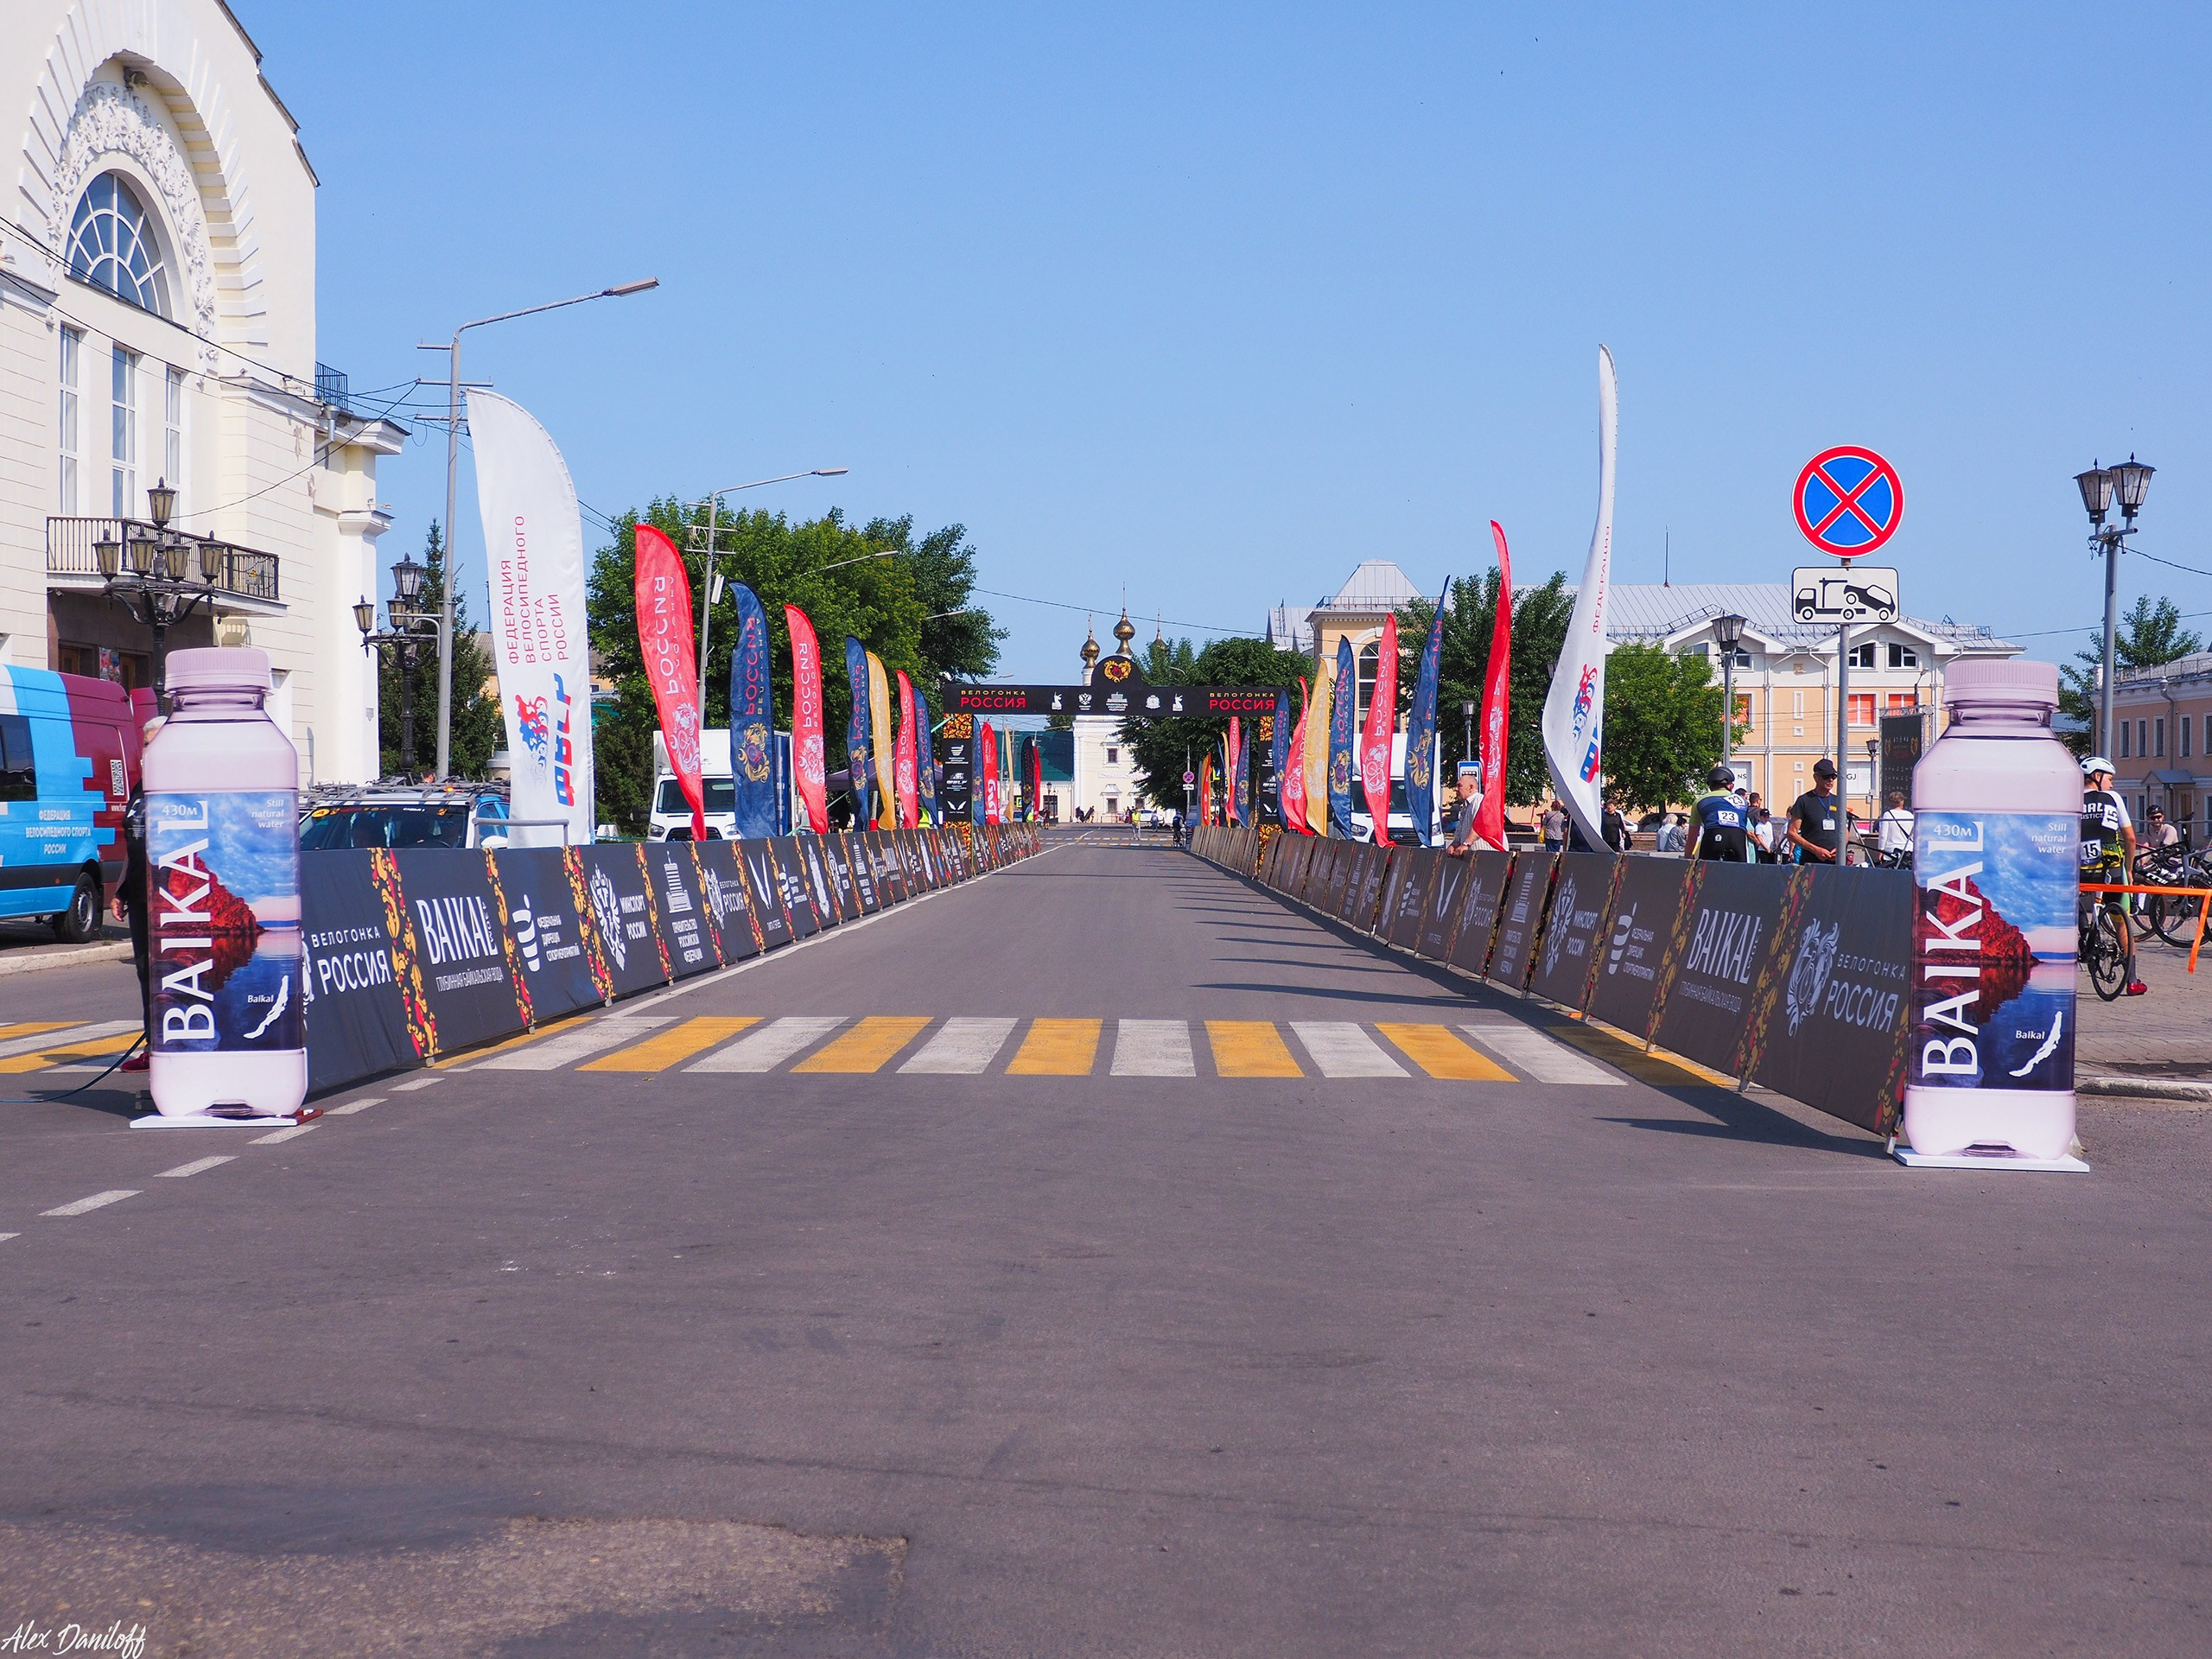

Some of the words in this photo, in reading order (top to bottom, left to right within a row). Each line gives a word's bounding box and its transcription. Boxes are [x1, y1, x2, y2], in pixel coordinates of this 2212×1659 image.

[514, 516, 537, 664] ВЕЛОСИПЕДНОГО
[500, 560, 519, 664] ФЕДЕРАЦИЯ
[534, 598, 552, 662] СПОРТА
[547, 594, 569, 660] РОССИИ
[960, 696, 1026, 708] РОССИЯ
[1209, 699, 1274, 710] РОССИЯ
[1728, 794, 1742, 805] 23
[38, 810, 71, 821] ФЕДЕРАЦИЯ
[251, 810, 284, 818] natural
[1721, 811, 1735, 822] 23
[71, 826, 92, 837] СПОРТА
[2048, 823, 2067, 832] Still
[2031, 834, 2067, 842] natural
[43, 843, 67, 854] РОССИИ
[2037, 845, 2067, 855] water
[2082, 842, 2099, 858] 15
[157, 800, 216, 1045] BAIKAL
[311, 926, 381, 948] ВЕЛОГОНКА
[416, 896, 499, 965] BAIKAL
[1686, 908, 1763, 985] BAIKAL
[1922, 822, 1984, 1078] BAIKAL
[317, 950, 391, 995] РОССИЯ
[1837, 953, 1906, 980] ВЕЛОГОНКА
[247, 995, 275, 1003] Baikal
[1823, 980, 1899, 1033] РОССИЯ
[2015, 1030, 2045, 1039] Baikal
